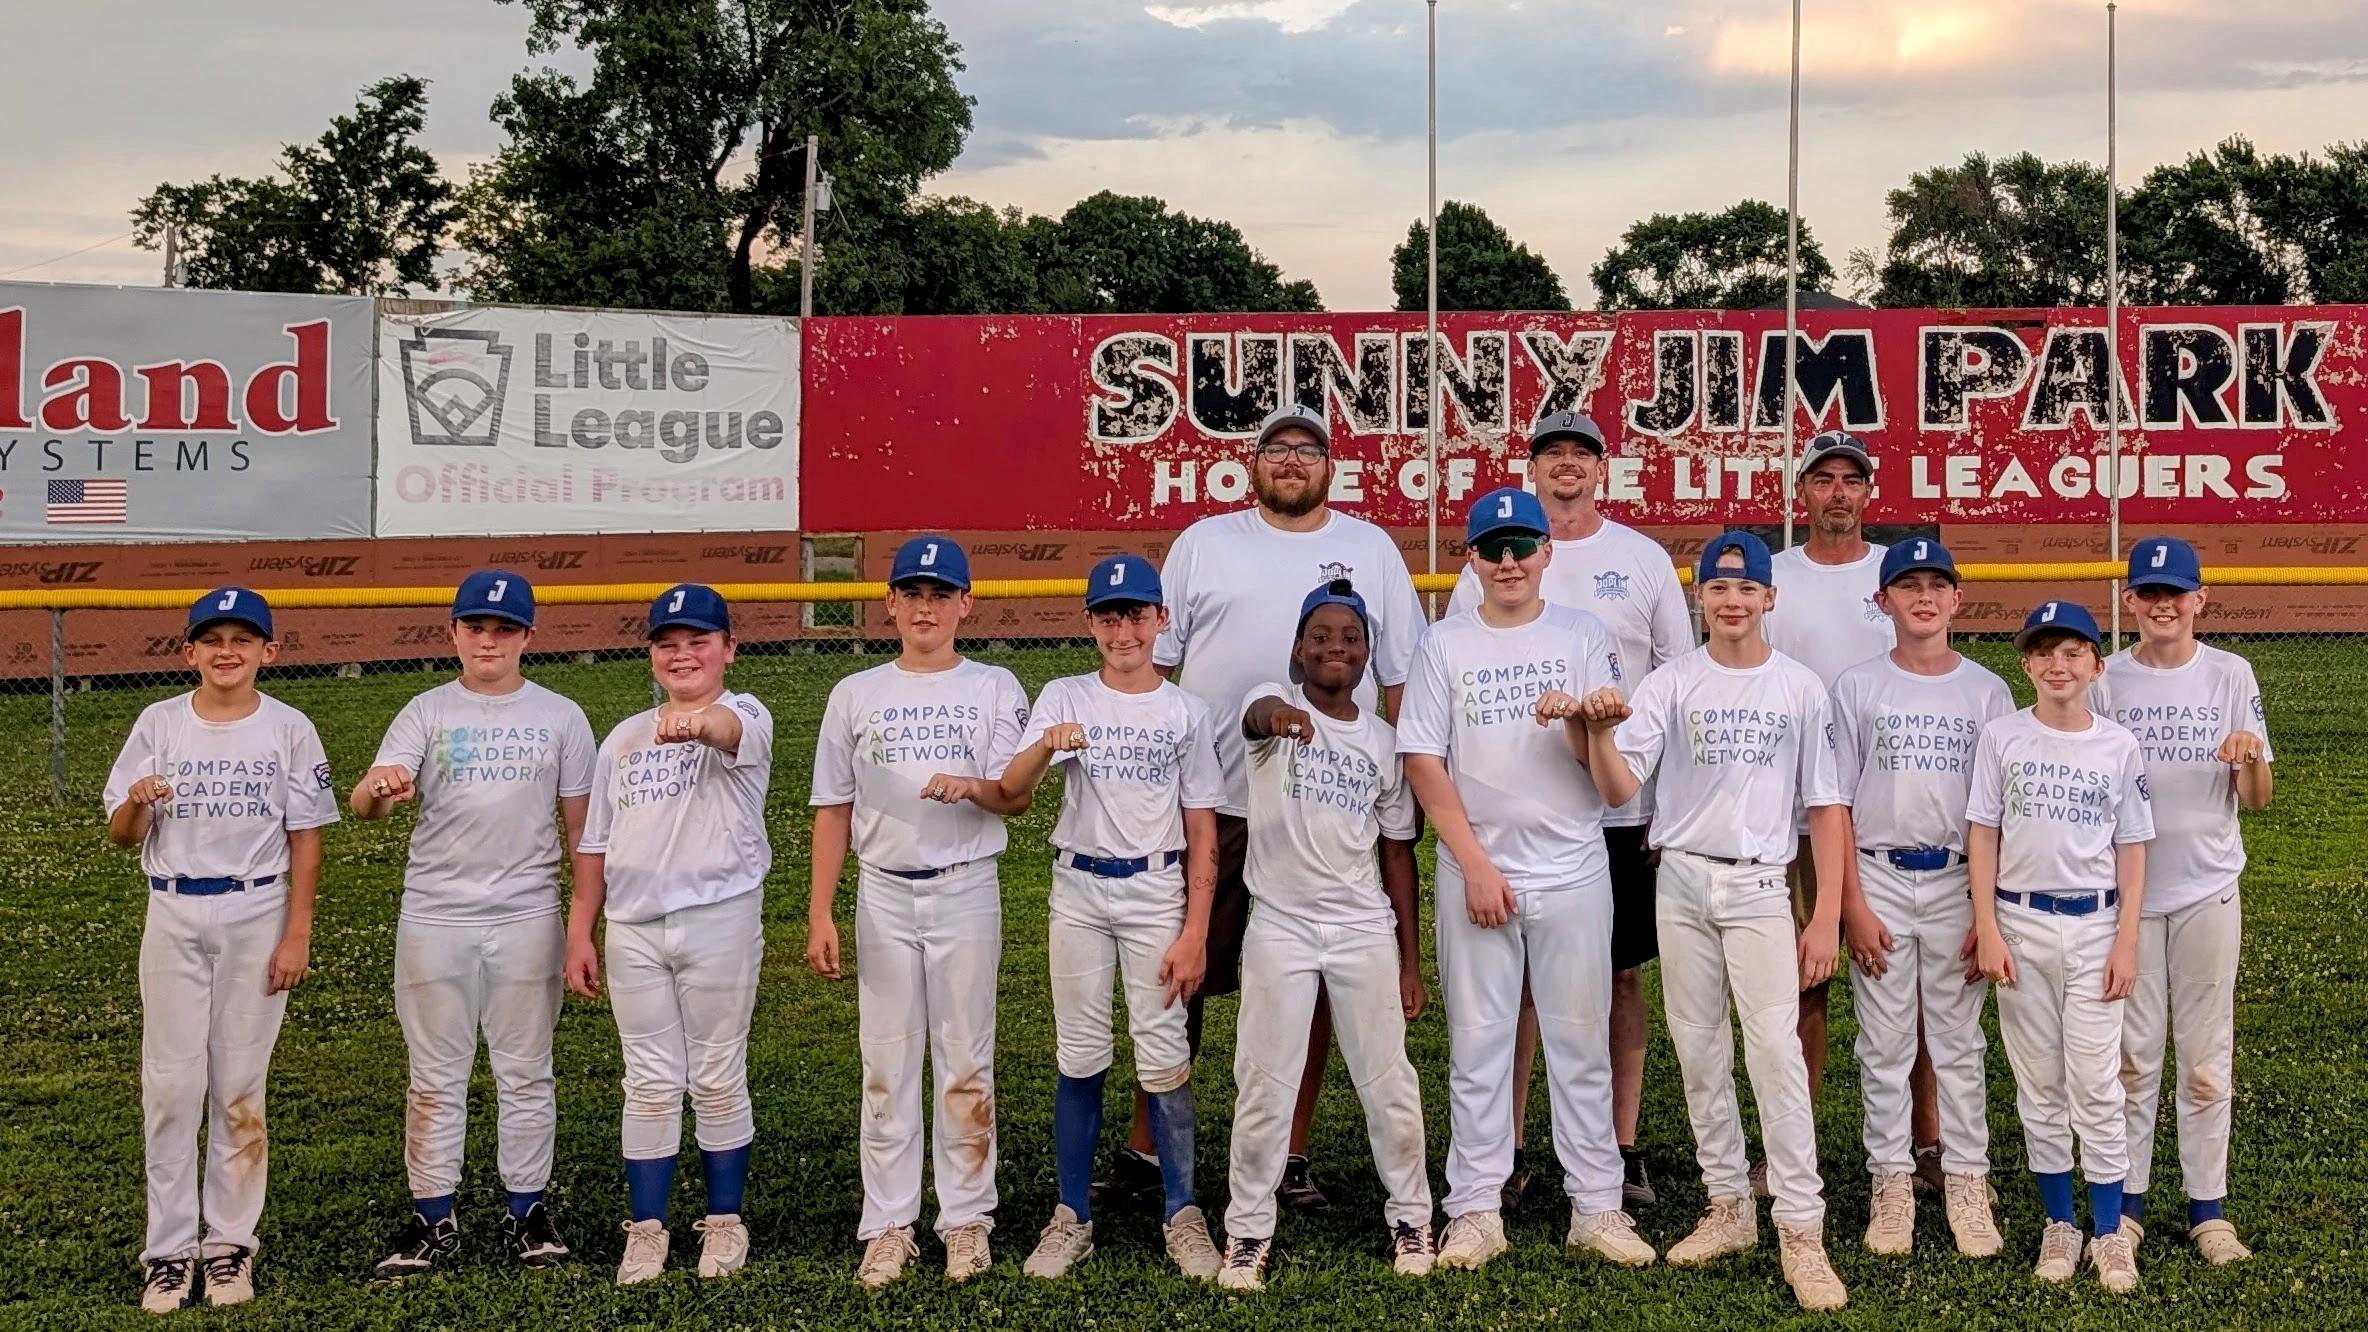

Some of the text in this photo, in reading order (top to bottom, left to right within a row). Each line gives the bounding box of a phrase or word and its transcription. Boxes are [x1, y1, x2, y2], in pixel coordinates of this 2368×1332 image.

[535, 332, 710, 392] Little
[1091, 321, 2338, 444] SUNNY JIM PARK
[535, 393, 784, 464] League
[1560, 411, 1577, 429] J
[396, 462, 785, 512] Official Program
[1154, 459, 1364, 503] HOE
[1398, 458, 1477, 501] OF
[1507, 457, 1644, 501] TE
[1911, 453, 2287, 500] LEAGUERS
[1498, 495, 1512, 518] J
[921, 543, 938, 566] J
[1914, 541, 1928, 561] J
[2151, 545, 2167, 568] J
[1110, 563, 1125, 586] J
[219, 590, 237, 611] J
[488, 579, 507, 602] J
[668, 590, 686, 613] J
[2041, 602, 2057, 623] J
[1462, 658, 1566, 686] COMPASS
[1463, 678, 1567, 707] ACADEMY
[869, 704, 979, 725] COMPASS
[1466, 703, 1537, 728] NETWO
[1689, 708, 1789, 729] COMPASS
[1875, 714, 1976, 735] COMPASS
[2116, 705, 2220, 724] COMPASS
[869, 723, 978, 746] ACADEMY
[1088, 725, 1176, 746] OMPASS
[1693, 728, 1784, 748] ACADEMY
[1875, 734, 1973, 754] ACADEMY
[2131, 725, 2220, 742] CADEMY
[871, 744, 976, 766] NETWORK
[1296, 745, 1379, 778] OMPASS
[1694, 748, 1776, 768] NETWORK
[1878, 755, 1969, 775] NETWORK
[2141, 746, 2219, 763] TWORK
[166, 759, 277, 778] COMPASS
[439, 765, 545, 783] NETWORK
[1090, 763, 1171, 783] ETWORK
[2010, 761, 2111, 790] COMPASS
[176, 781, 273, 798] CADEMY
[1282, 778, 1369, 816] NETWORK
[2010, 781, 2110, 807] ACADEMY
[2011, 801, 2103, 828] NETWORK
